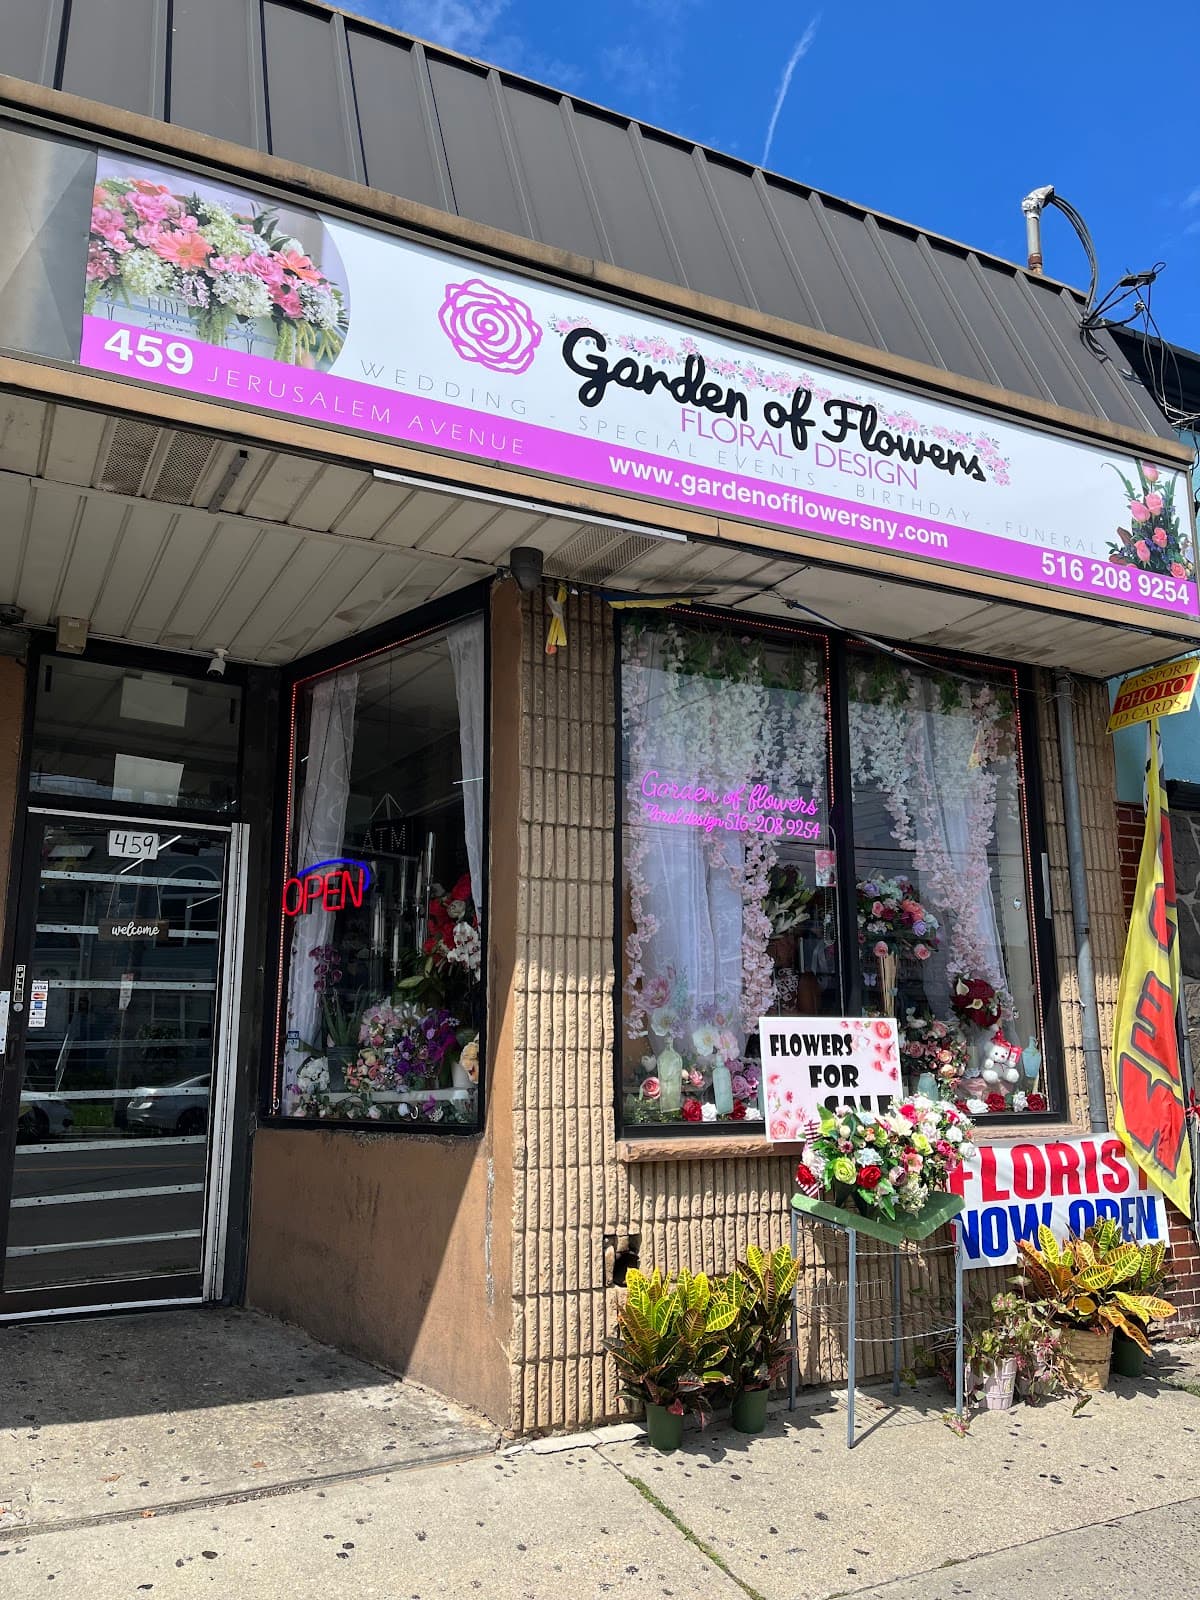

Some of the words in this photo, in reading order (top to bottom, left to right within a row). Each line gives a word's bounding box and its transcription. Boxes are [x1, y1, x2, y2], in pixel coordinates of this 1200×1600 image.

[104, 328, 194, 376] 459
[207, 366, 391, 425] JERUSALEM
[408, 415, 524, 456] AVENUE
[562, 327, 748, 421] Garden
[764, 386, 817, 450] of
[822, 398, 987, 482] Flowers
[360, 359, 528, 415] WEDDING
[578, 415, 697, 459] SPECIAL
[718, 450, 816, 487] EVENTS
[856, 484, 972, 522] BIRTHDAY
[1004, 521, 1097, 555] FUNERAL
[681, 407, 793, 459] FLORAL
[815, 442, 918, 490] DESIGN
[609, 453, 949, 549] www.gardenofflowersny.com
[1041, 552, 1085, 582] 516
[1090, 562, 1132, 593] 208
[1138, 574, 1191, 605] 9254
[1124, 662, 1193, 692] PASSPORT
[1119, 677, 1187, 712] PHOTO
[1131, 698, 1182, 720] CARDS
[722, 783, 747, 811] of
[748, 784, 819, 816] flowers
[361, 823, 406, 854] ATM
[683, 810, 725, 833] design
[114, 833, 154, 856] 459
[282, 868, 365, 917] OPEN
[111, 921, 161, 937] welcome
[769, 1033, 853, 1058] FLOWERS
[808, 1064, 860, 1089] FOR
[952, 1202, 1053, 1260] NOW
